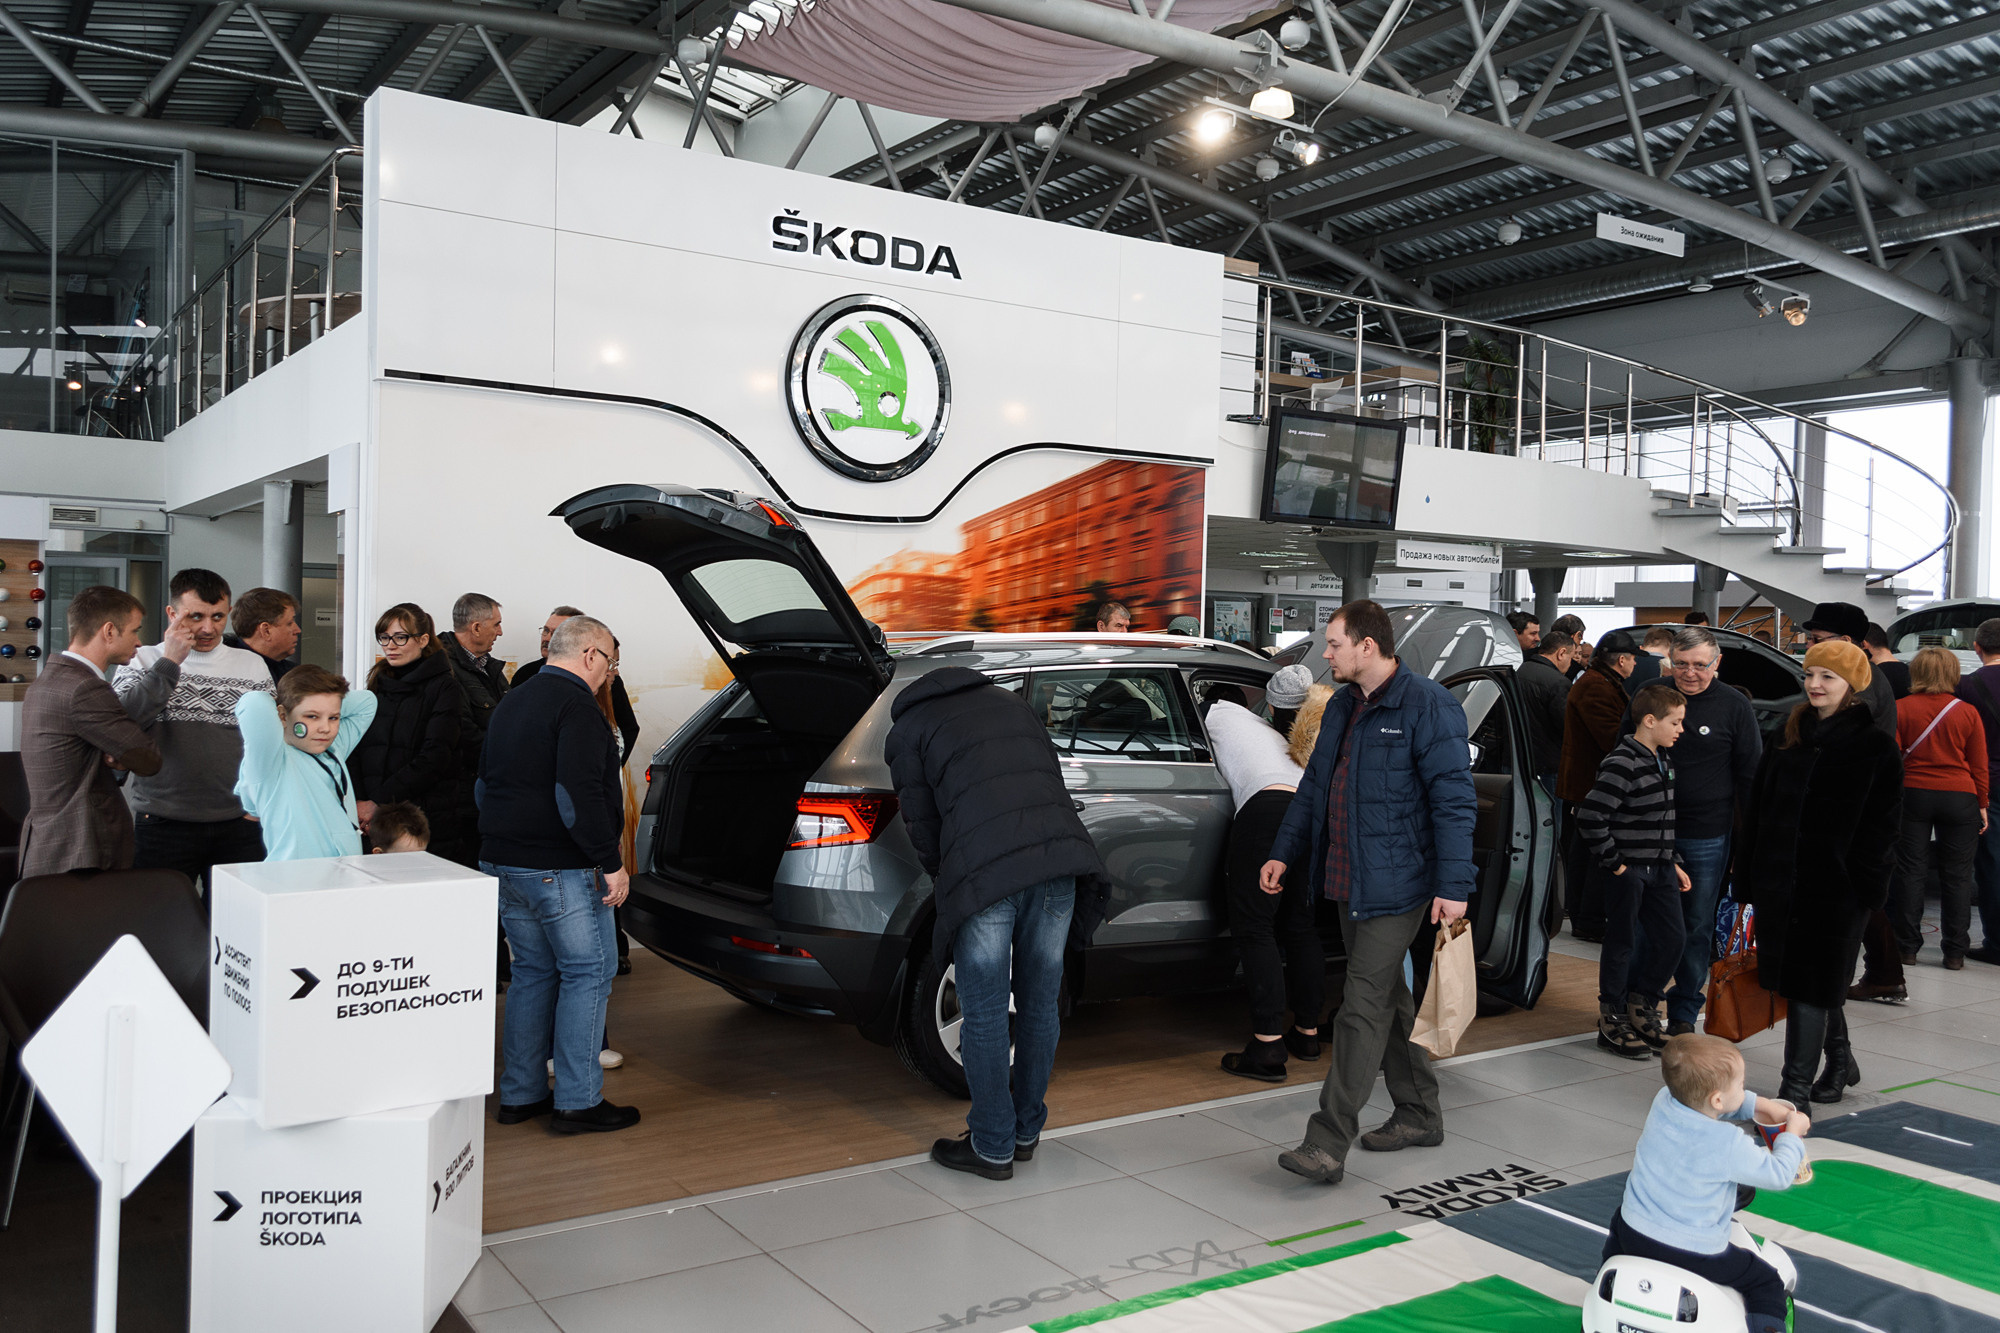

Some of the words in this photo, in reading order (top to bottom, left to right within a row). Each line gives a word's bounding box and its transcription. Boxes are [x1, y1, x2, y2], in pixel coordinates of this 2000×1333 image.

[772, 208, 962, 280] ŠKODA
[1620, 226, 1635, 237] Зона
[1635, 231, 1664, 243] ожидания
[1400, 549, 1432, 560] Продажа
[1433, 553, 1455, 562] новых
[1457, 554, 1500, 565] автомобилей
[337, 961, 366, 980] ДО
[372, 955, 414, 973] 9-ТИ
[224, 982, 231, 998] ПО
[337, 974, 431, 998] ПОДУШЕК
[336, 988, 483, 1019] БЕЗОПАСНОСТИ
[1380, 1163, 1537, 1210] FAMILY
[261, 1190, 362, 1206] ПРОЕКЦИЯ
[260, 1211, 363, 1226] ЛОГОТИПА
[260, 1227, 326, 1246] ŠKODA
